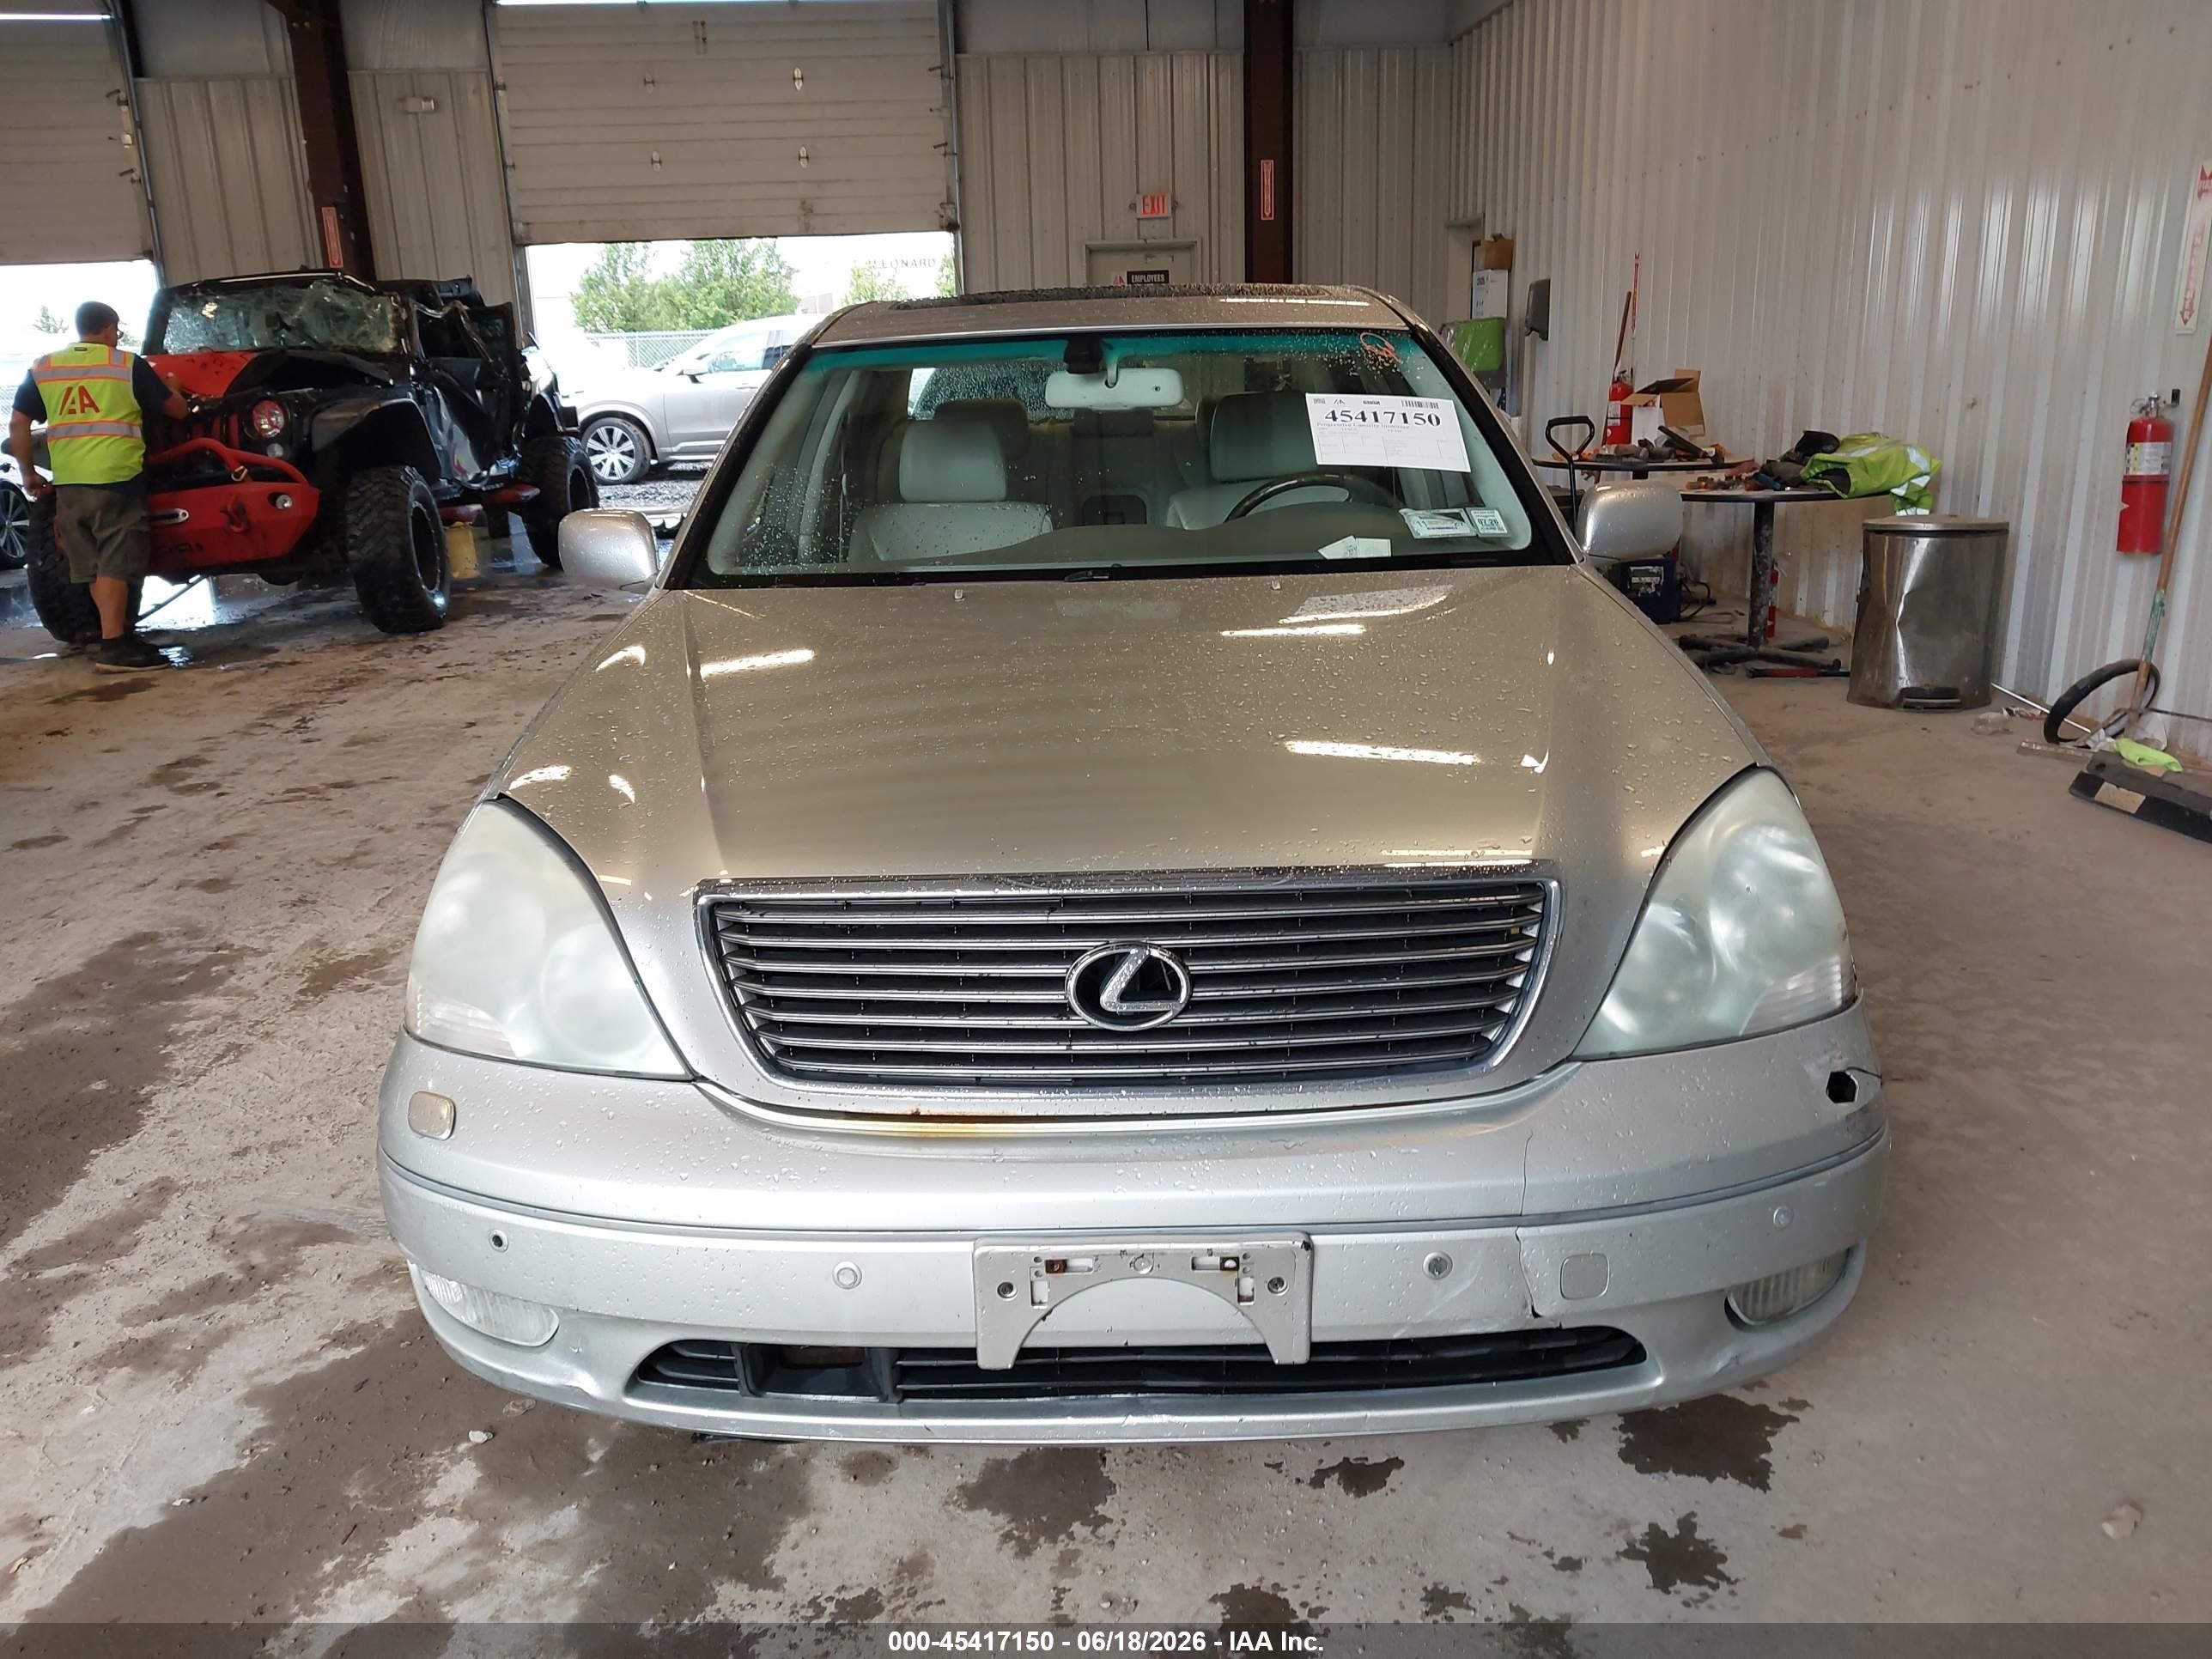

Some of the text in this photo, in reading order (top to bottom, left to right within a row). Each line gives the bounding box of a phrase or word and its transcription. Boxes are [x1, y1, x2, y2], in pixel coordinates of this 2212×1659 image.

[1142, 194, 1166, 216] EXIT
[1131, 274, 1165, 283] EMPLOYEES
[1325, 410, 1441, 427] 45417150
